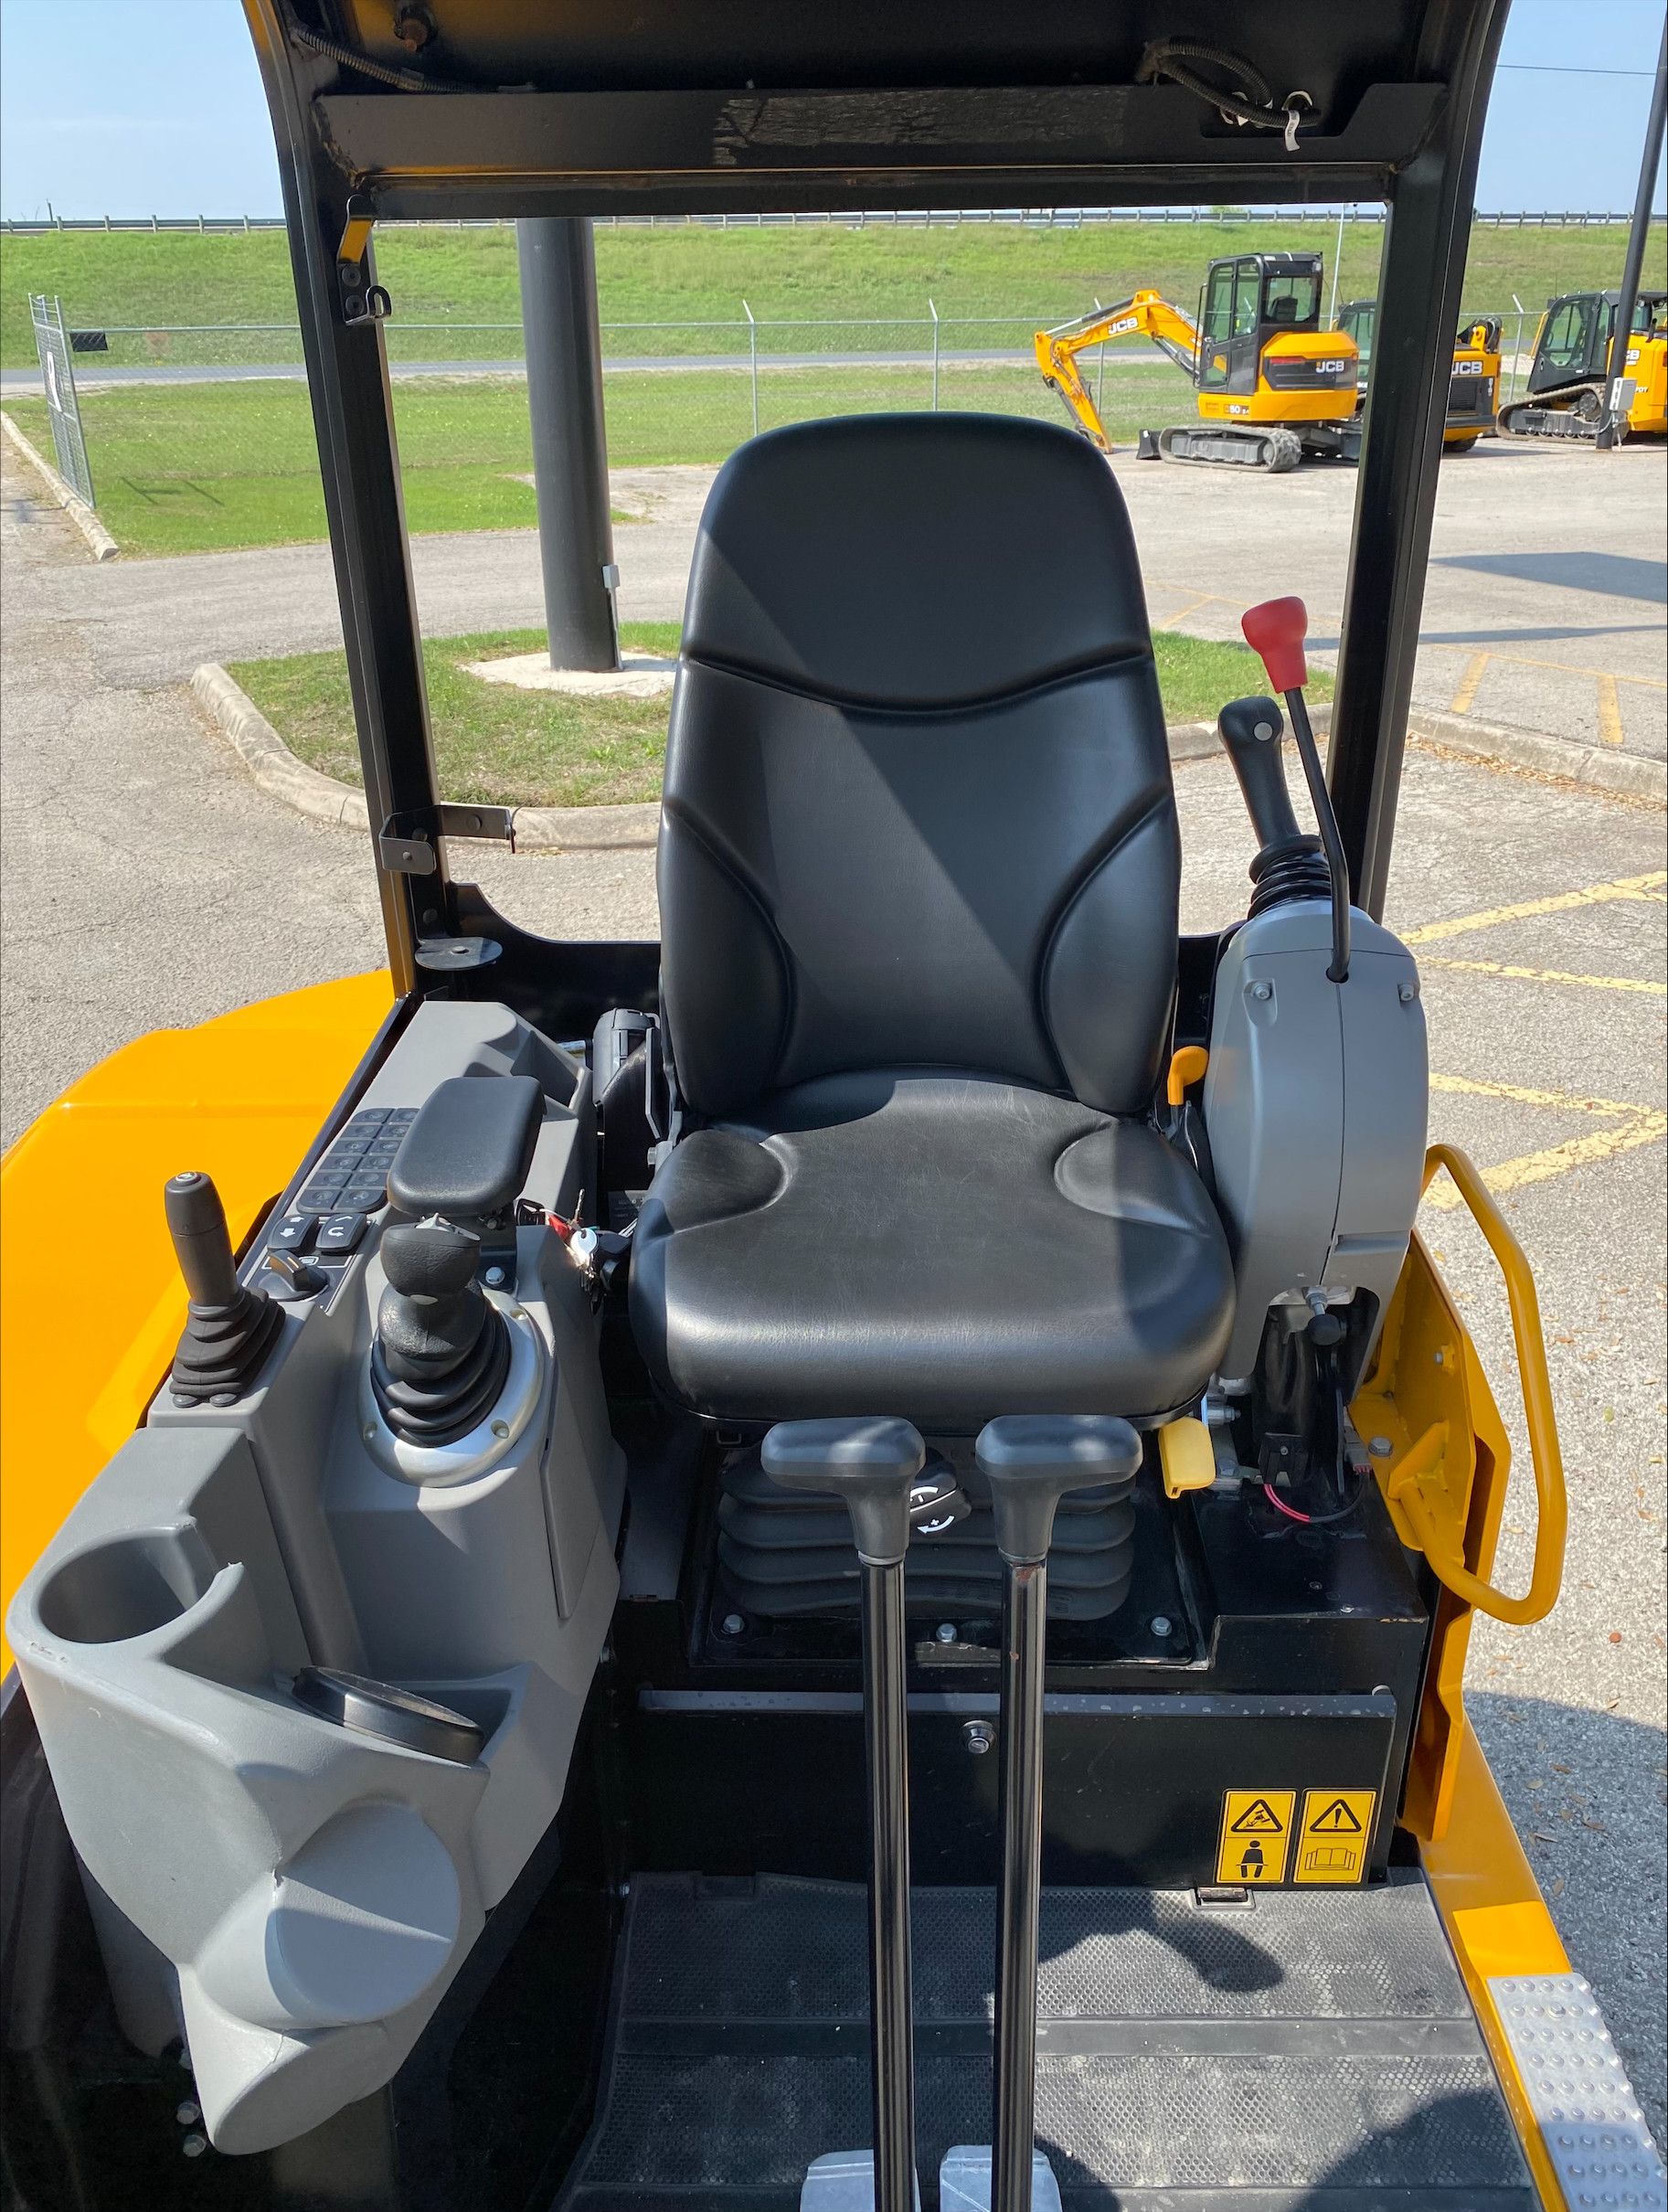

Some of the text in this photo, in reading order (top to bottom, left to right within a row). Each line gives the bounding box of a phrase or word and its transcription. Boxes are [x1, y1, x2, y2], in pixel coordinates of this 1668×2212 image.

[1108, 316, 1139, 335] JCB
[1316, 361, 1344, 373] JCB
[1451, 361, 1482, 375] JCB
